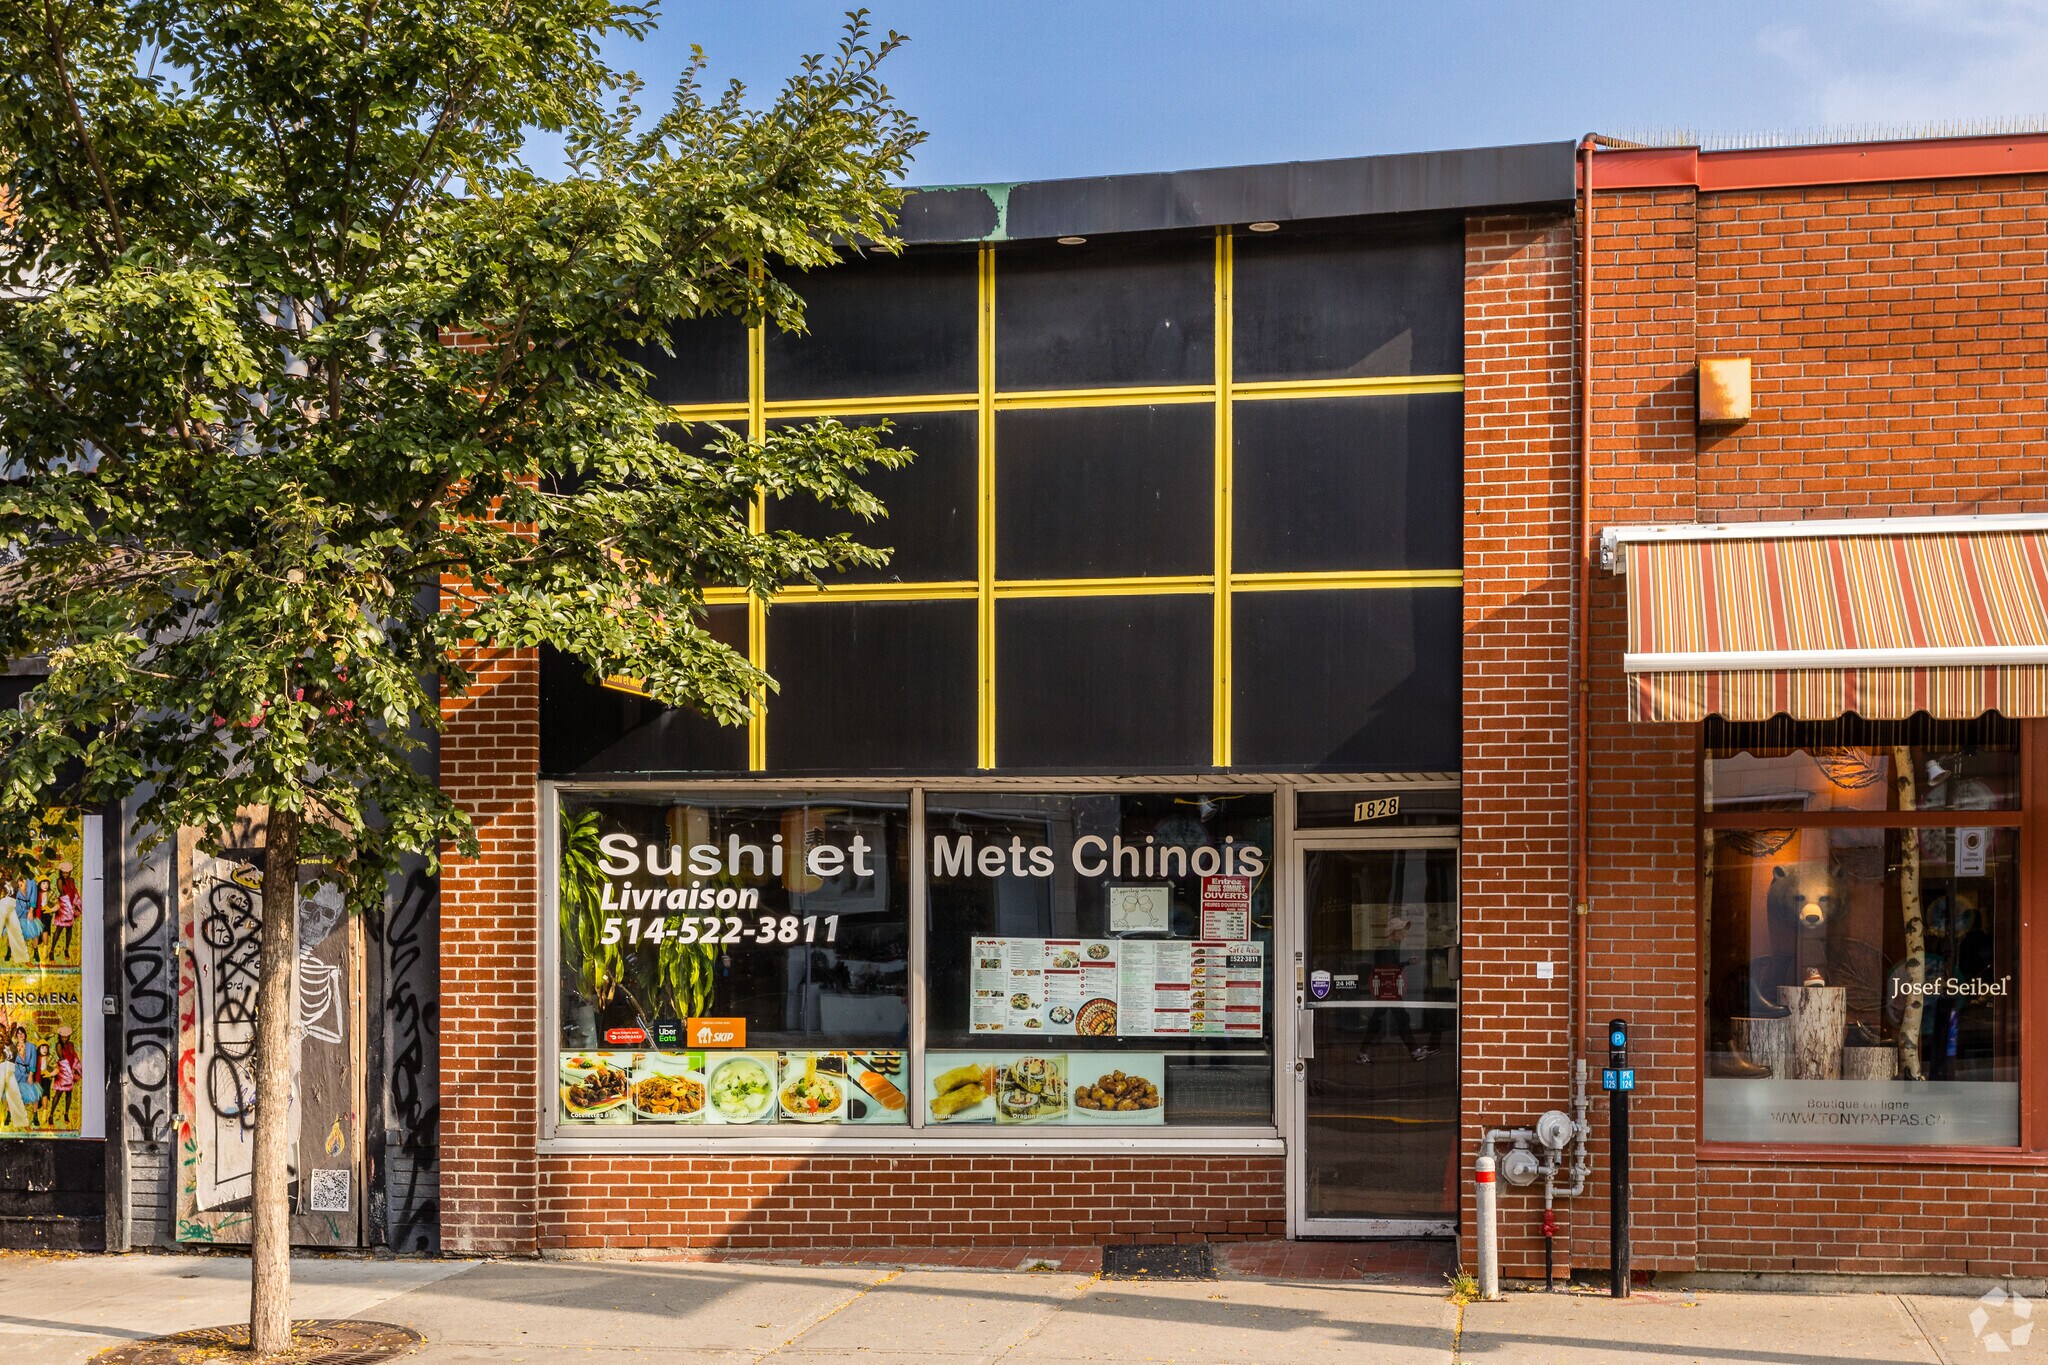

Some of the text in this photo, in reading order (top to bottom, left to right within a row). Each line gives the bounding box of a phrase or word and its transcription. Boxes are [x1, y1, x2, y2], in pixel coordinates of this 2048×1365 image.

[1357, 798, 1397, 820] 1828
[598, 833, 783, 877] Sushi
[807, 835, 875, 877] et
[933, 835, 1264, 878] Mets Chinois
[600, 881, 759, 911] Livraison
[600, 915, 840, 945] 514-522-3811
[1891, 977, 2008, 999] Josef Seibel
[712, 1032, 735, 1042] SKIP
[1606, 1070, 1614, 1079] PK
[1622, 1070, 1631, 1079] PK
[1605, 1080, 1616, 1089] 125
[1622, 1080, 1633, 1089] 124
[1807, 1099, 1860, 1110] Boutique
[1881, 1099, 1909, 1110] ligne
